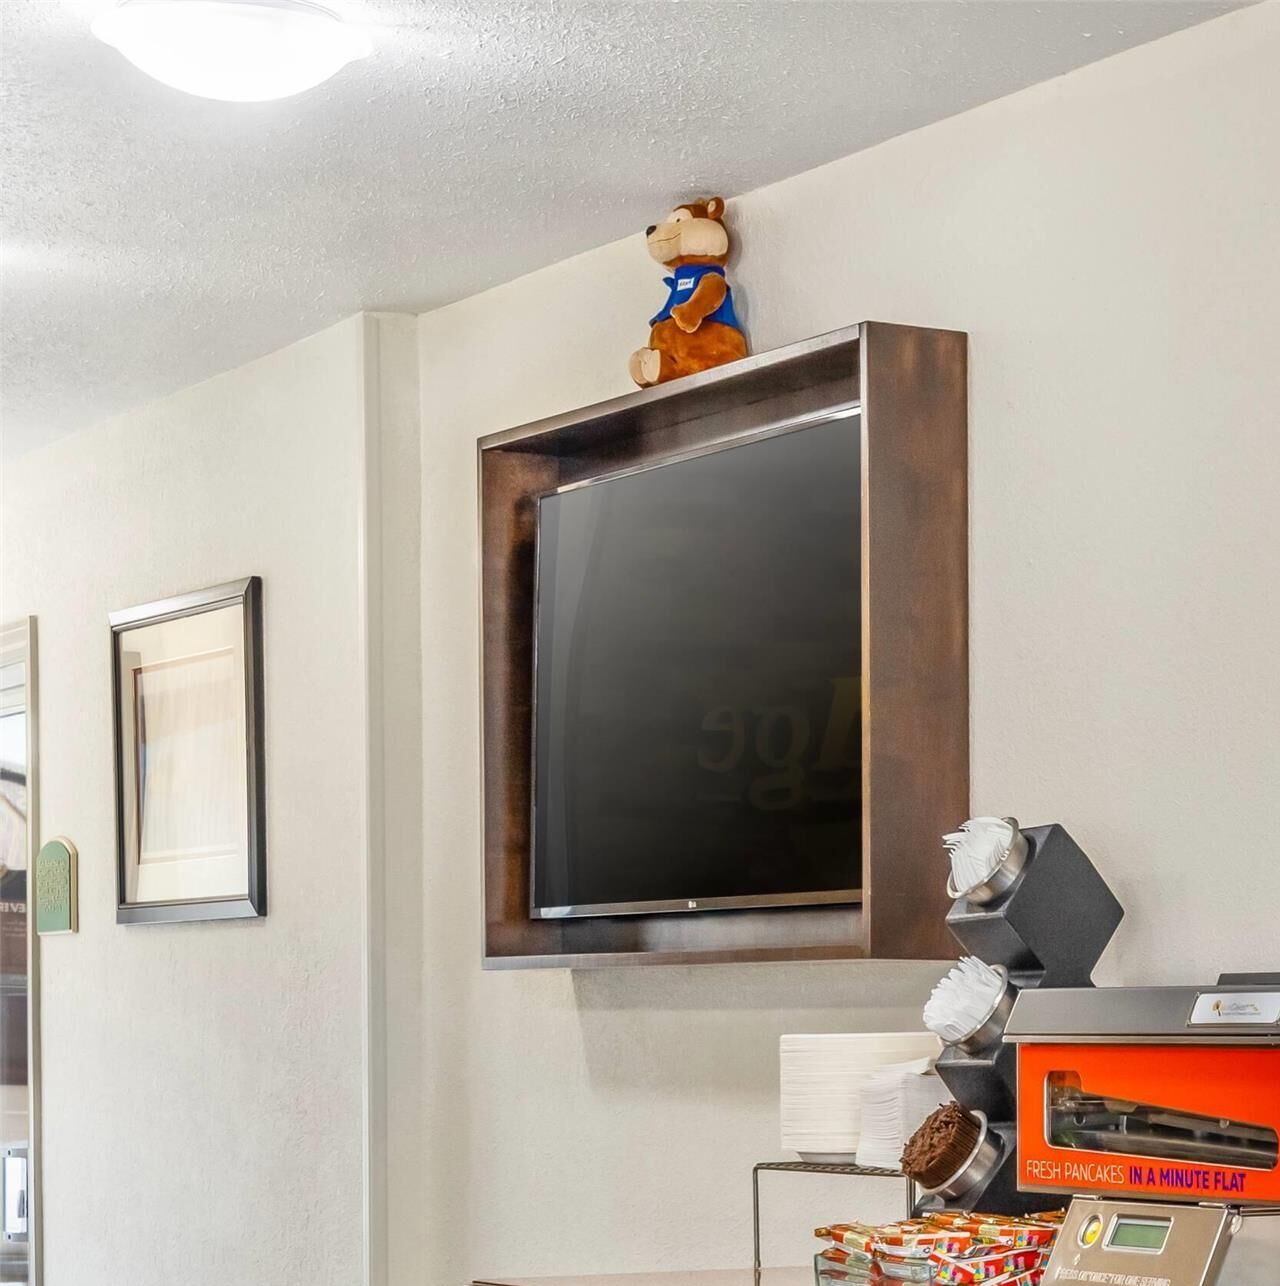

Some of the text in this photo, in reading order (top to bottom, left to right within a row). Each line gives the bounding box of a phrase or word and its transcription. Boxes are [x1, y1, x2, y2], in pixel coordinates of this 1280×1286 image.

[1026, 1160, 1246, 1192] FRESH PANCAKES IN A MINUTE FLAT
